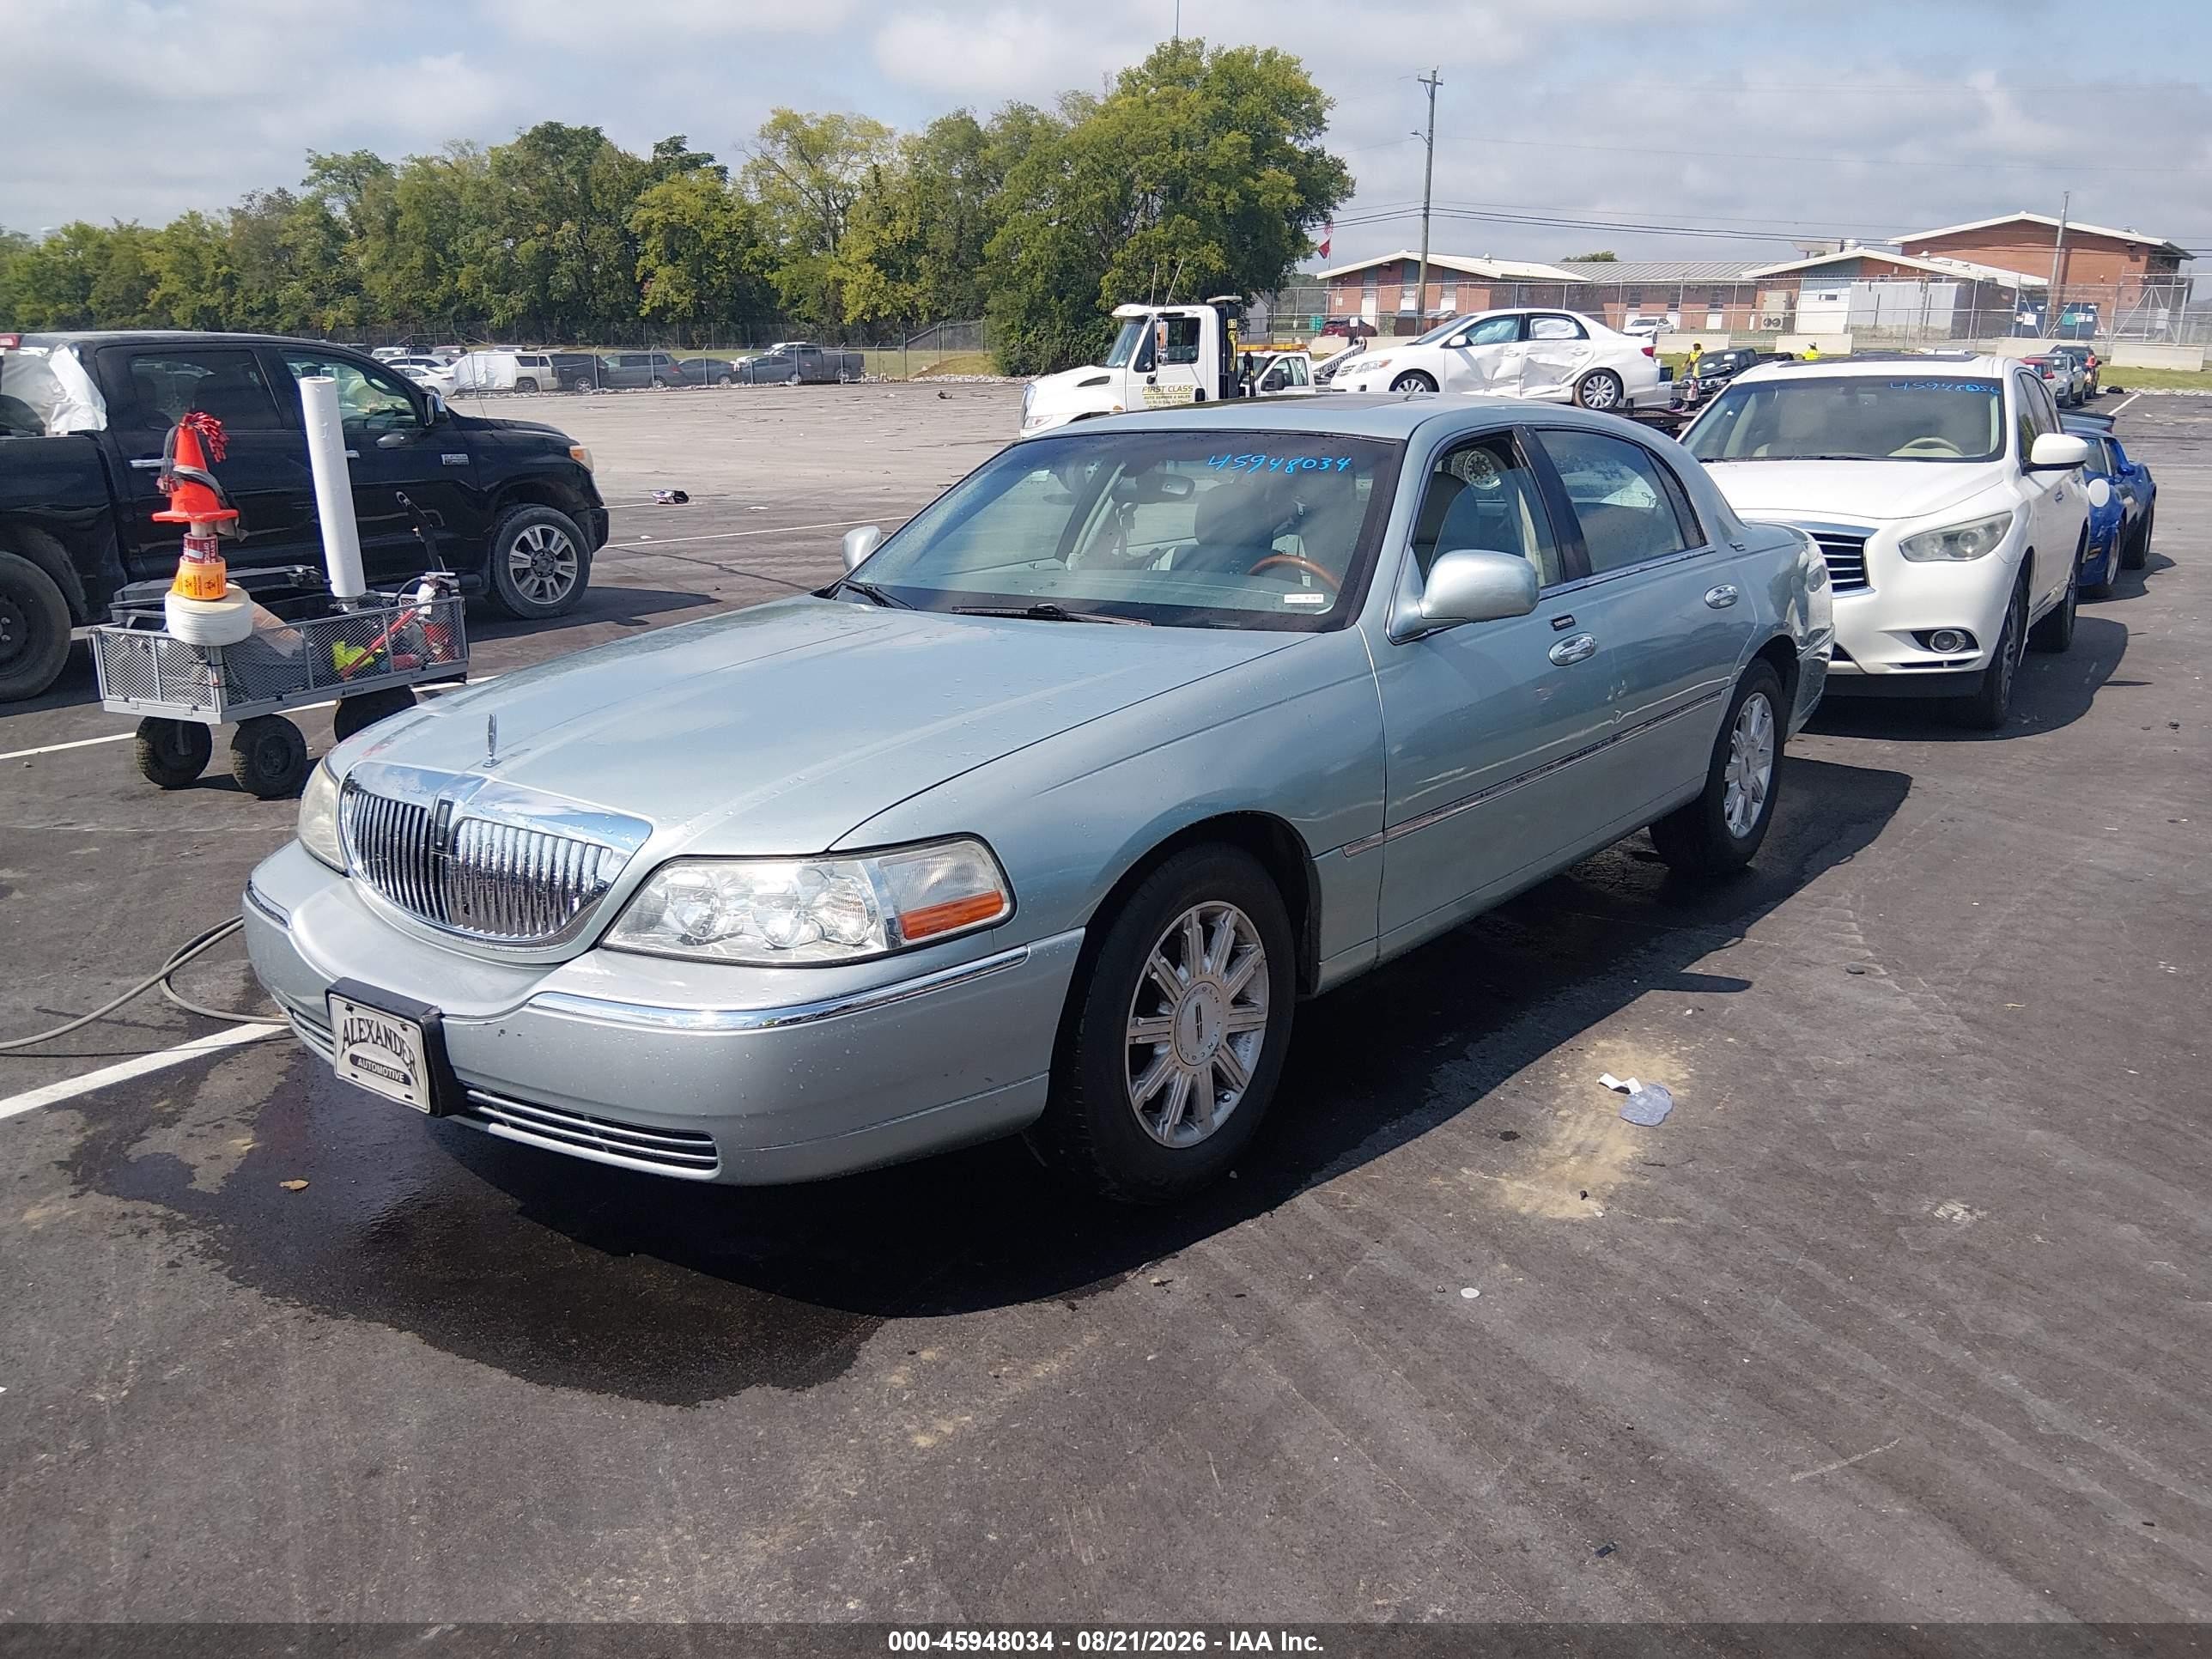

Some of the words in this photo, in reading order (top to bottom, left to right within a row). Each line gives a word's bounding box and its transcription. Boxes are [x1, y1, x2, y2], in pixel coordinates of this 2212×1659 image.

[1207, 453, 1352, 473] 45948034
[340, 1017, 422, 1091] ALEXANDER
[356, 1056, 405, 1083] AUTOMOTIVE
